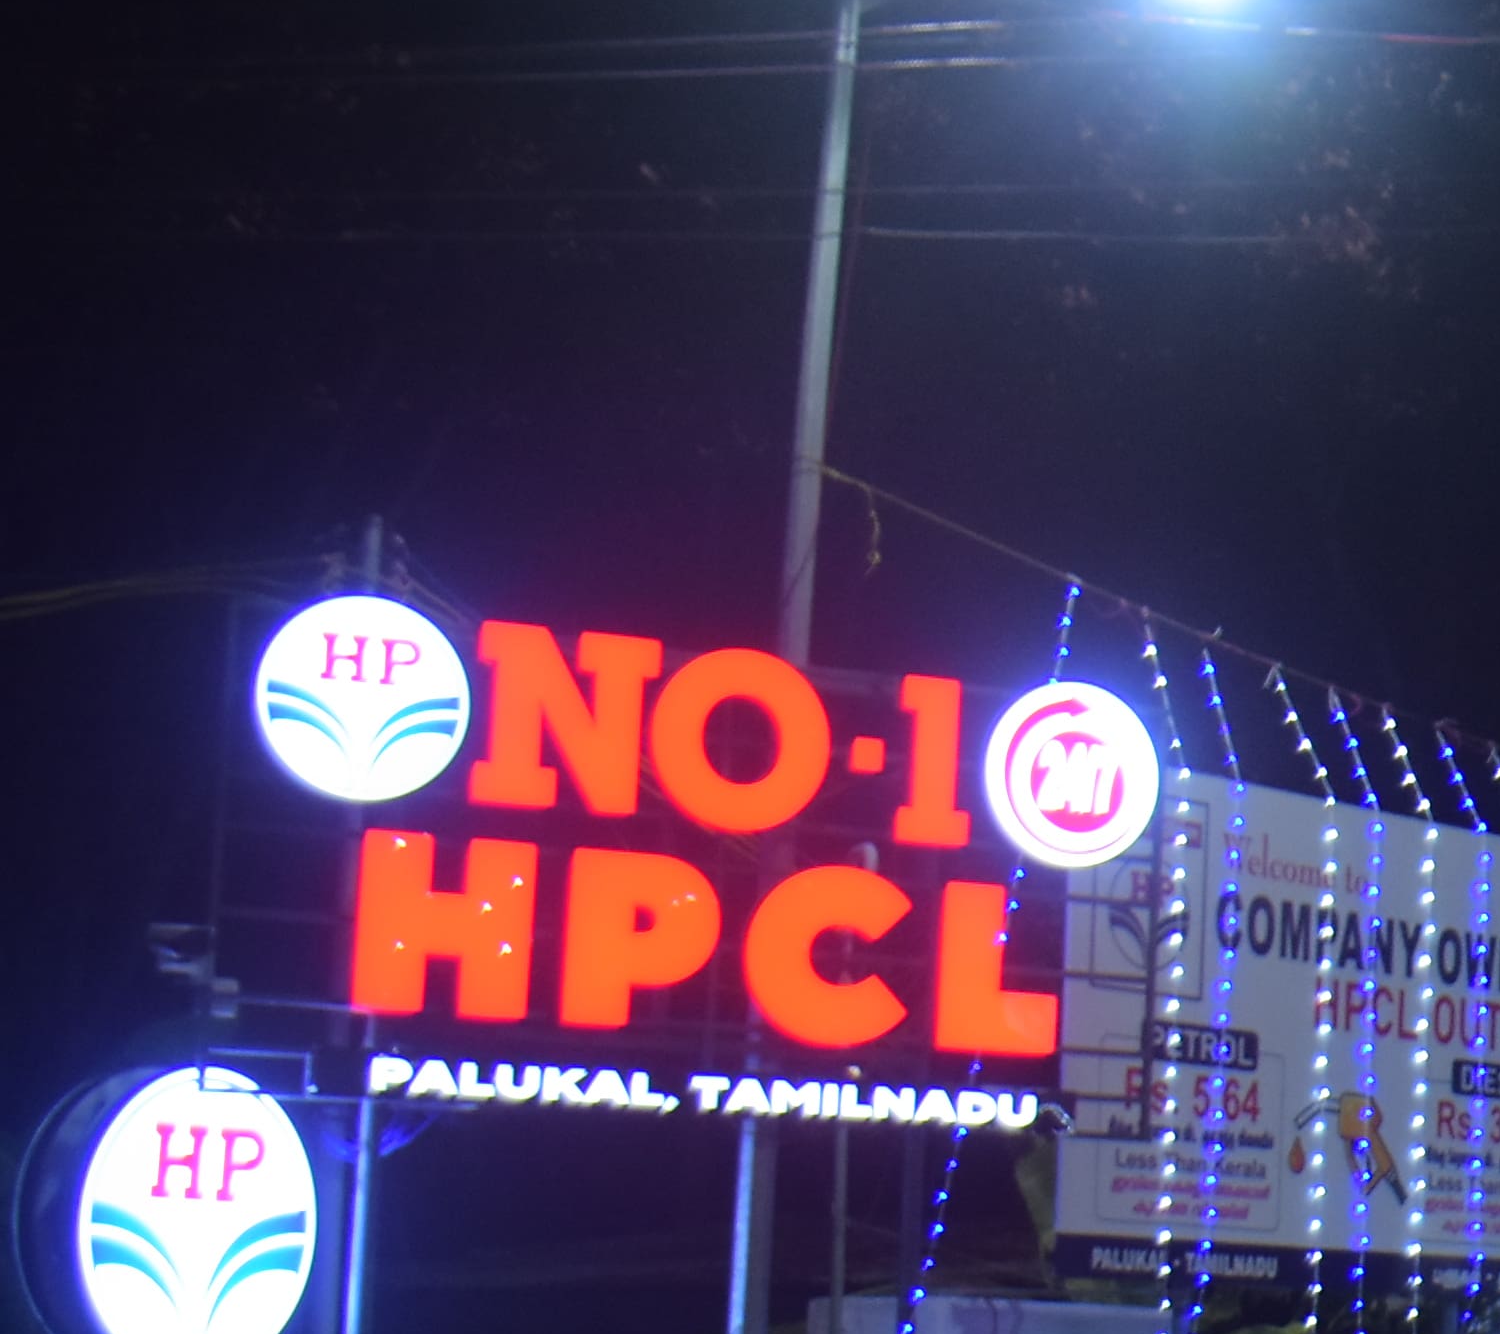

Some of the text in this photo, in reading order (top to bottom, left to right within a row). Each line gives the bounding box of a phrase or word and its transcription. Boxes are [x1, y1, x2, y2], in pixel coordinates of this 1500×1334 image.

[320, 633, 421, 685] HP
[1223, 833, 1337, 887] Welcome
[350, 827, 1057, 1057] HPCL
[1216, 892, 1421, 979] COMPANY
[1314, 977, 1418, 1041] HPCL
[1152, 1027, 1253, 1067] PETROL
[370, 1056, 1038, 1128] PALUKAL, TAMILNADU
[1194, 1075, 1260, 1123] 564
[151, 1122, 265, 1202] HP
